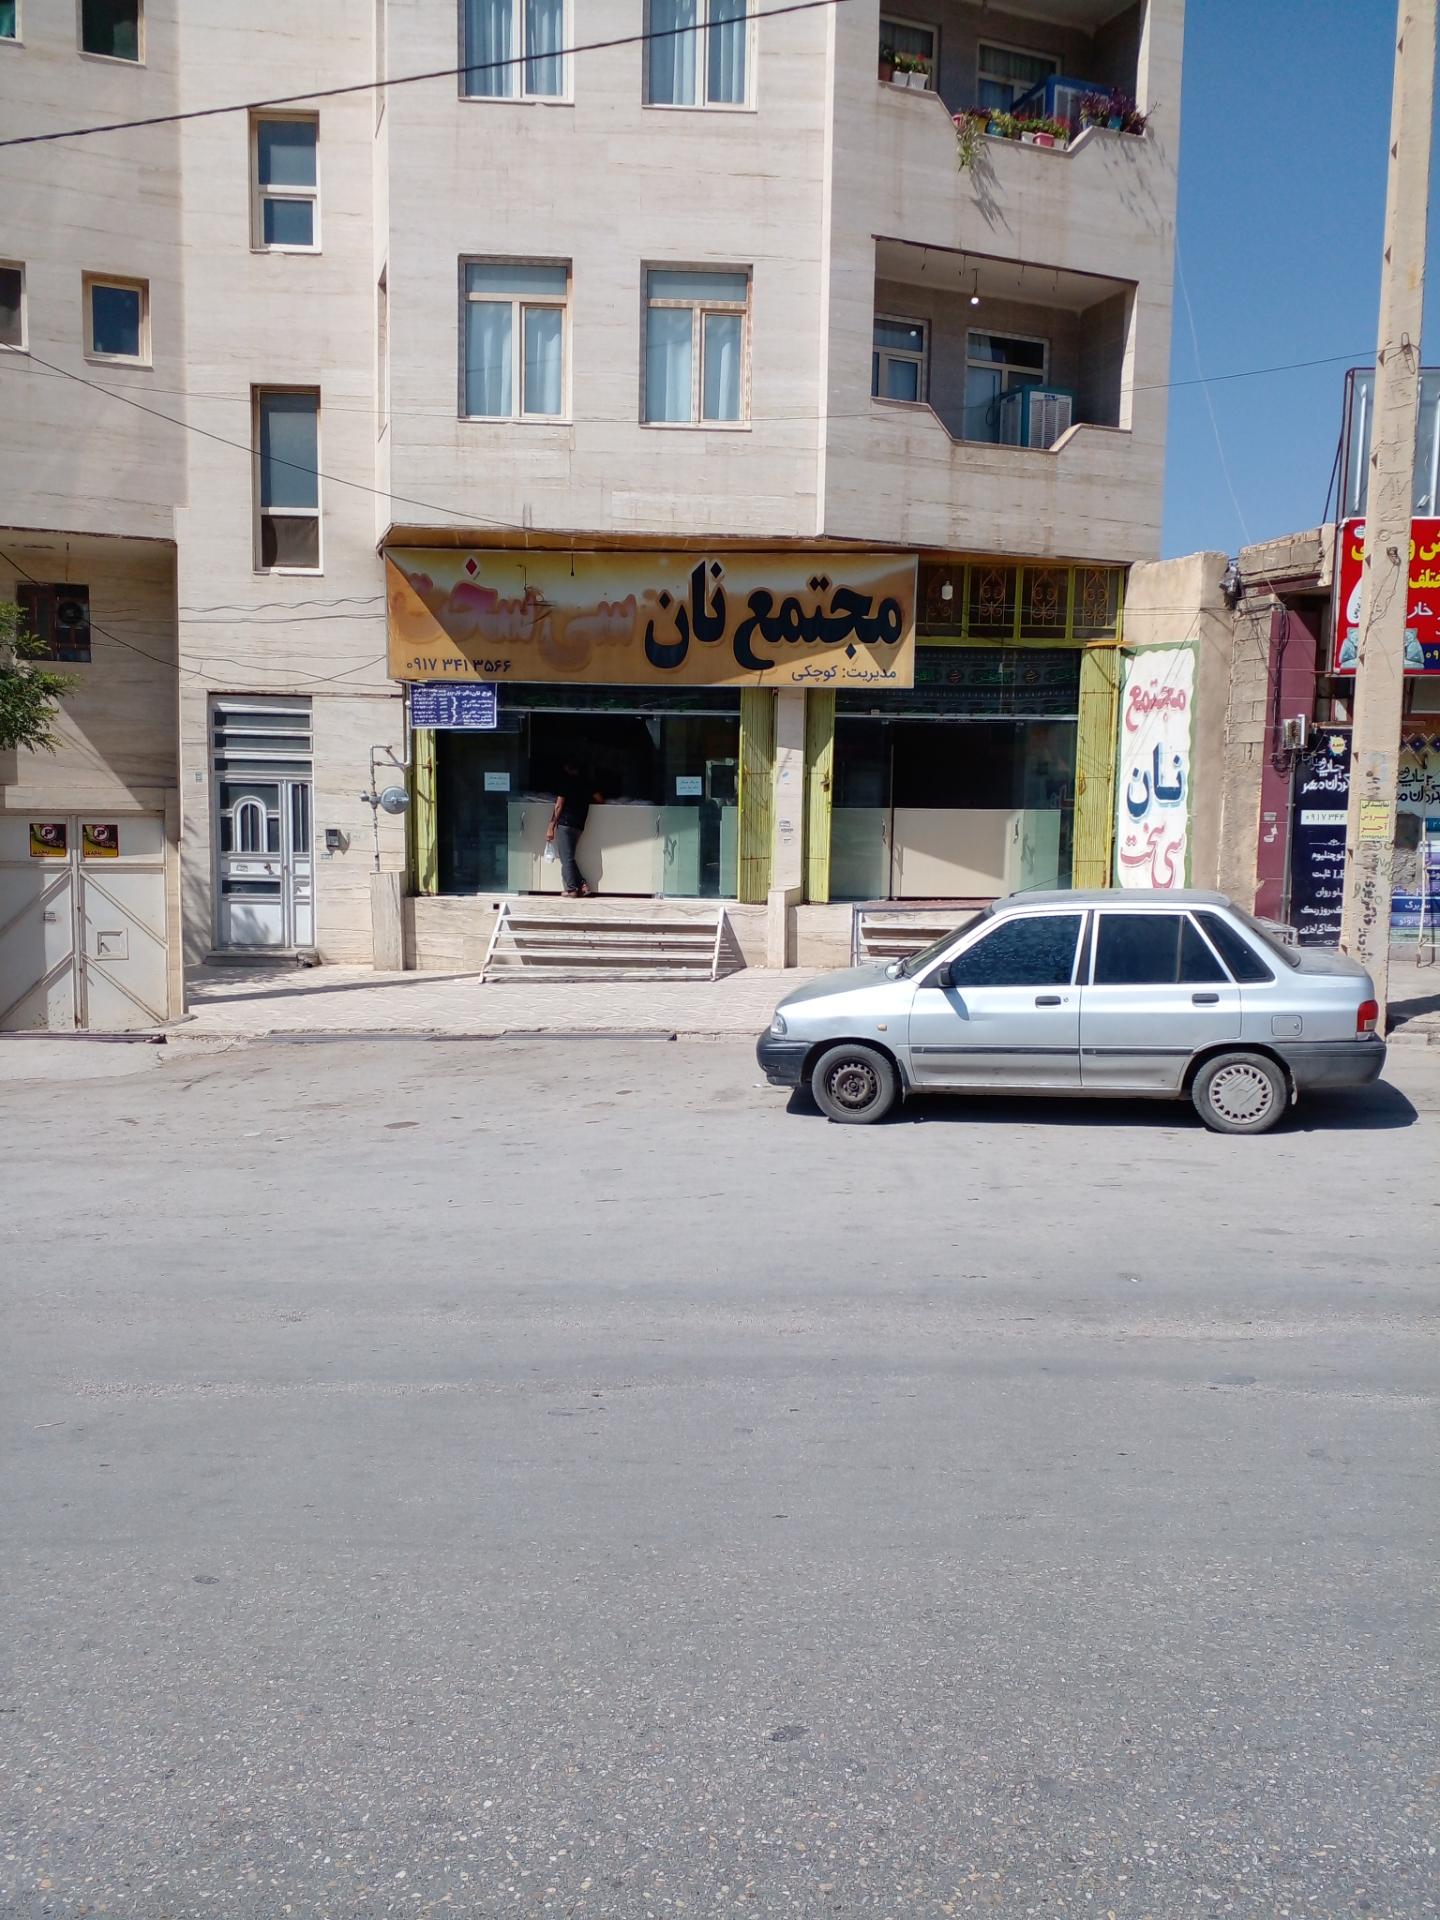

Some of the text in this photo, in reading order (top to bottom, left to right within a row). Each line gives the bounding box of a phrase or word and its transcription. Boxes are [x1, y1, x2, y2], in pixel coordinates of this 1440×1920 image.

[644, 560, 726, 669] نان
[733, 575, 903, 671] مجتمع
[406, 657, 512, 673] ۰۹۱۷ ۳۴۱ ۳۵۶۶
[791, 665, 838, 682] کوچکی
[842, 667, 897, 683] مدیریت:
[1125, 679, 1187, 733] مجتمع
[1126, 742, 1184, 818] نان
